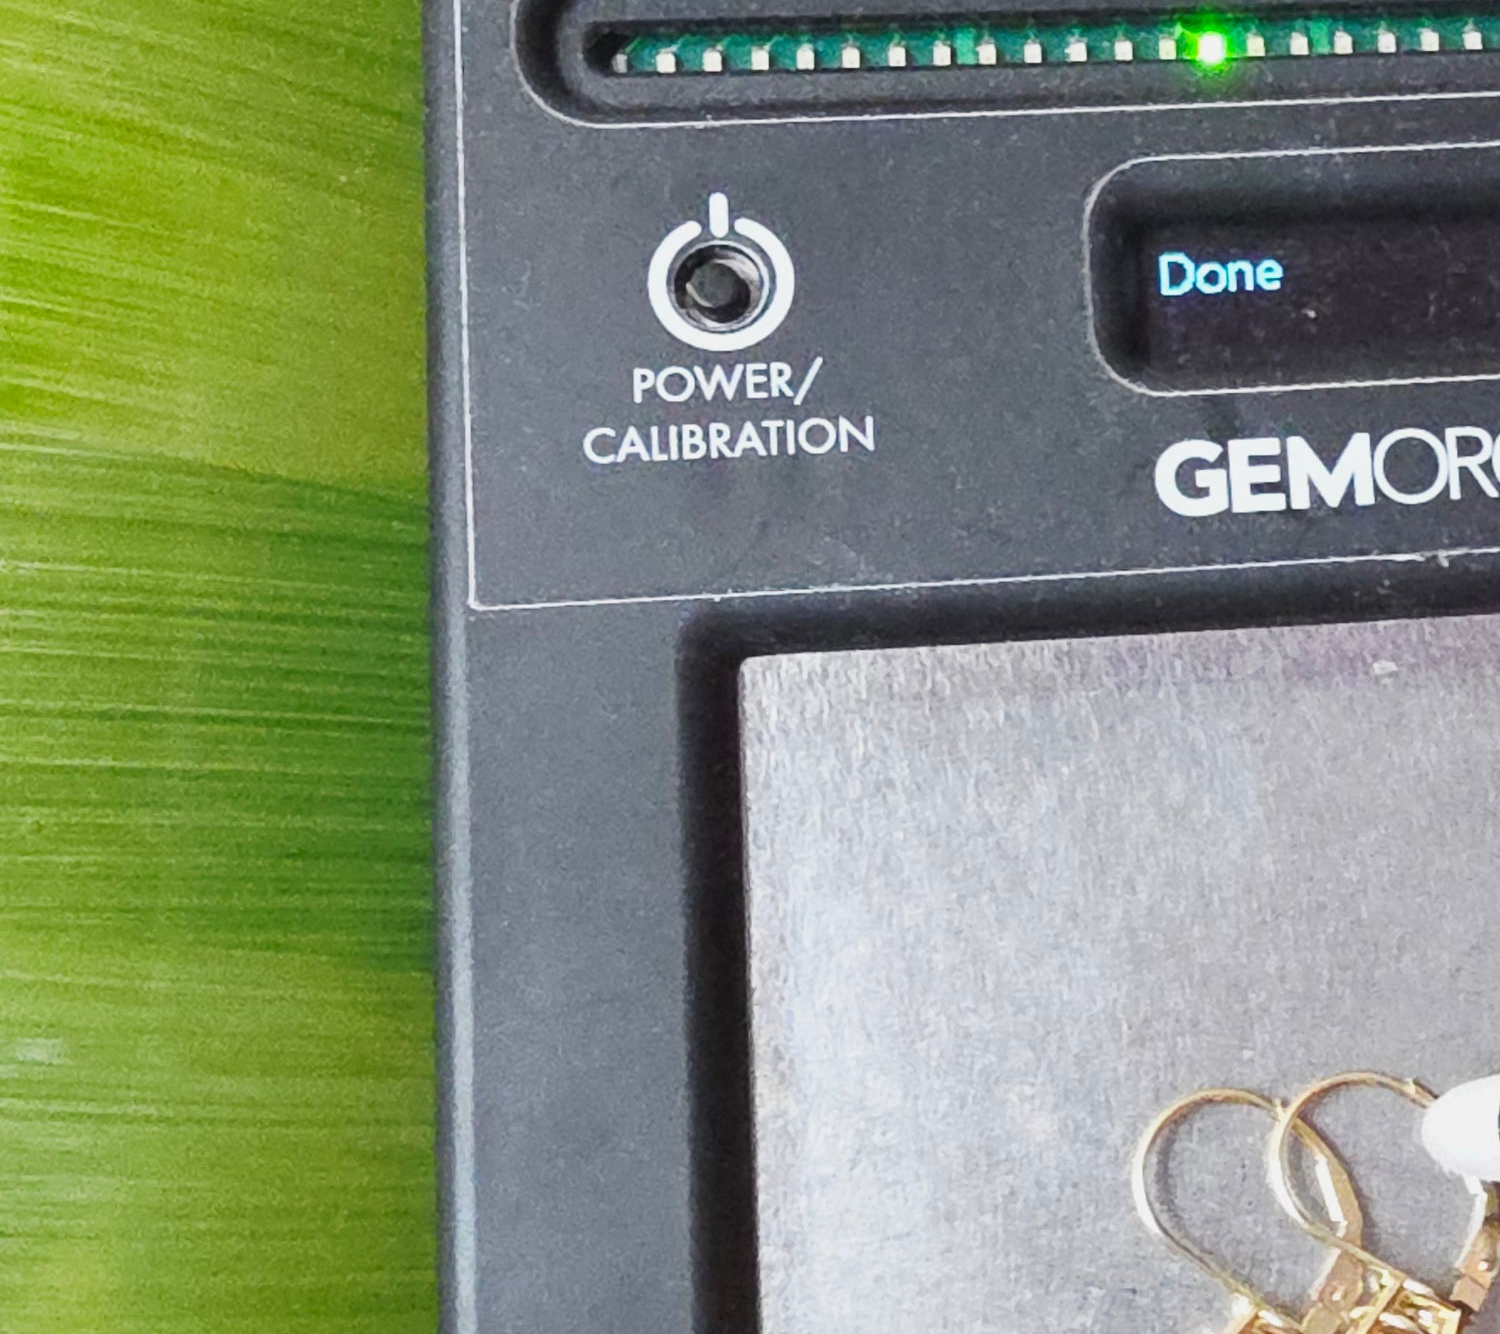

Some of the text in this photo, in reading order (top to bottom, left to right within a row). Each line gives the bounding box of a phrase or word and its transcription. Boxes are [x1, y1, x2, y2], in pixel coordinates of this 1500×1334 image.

[1157, 251, 1284, 297] Done
[632, 356, 824, 406] POWER/
[582, 415, 876, 466] CALIBRATION
